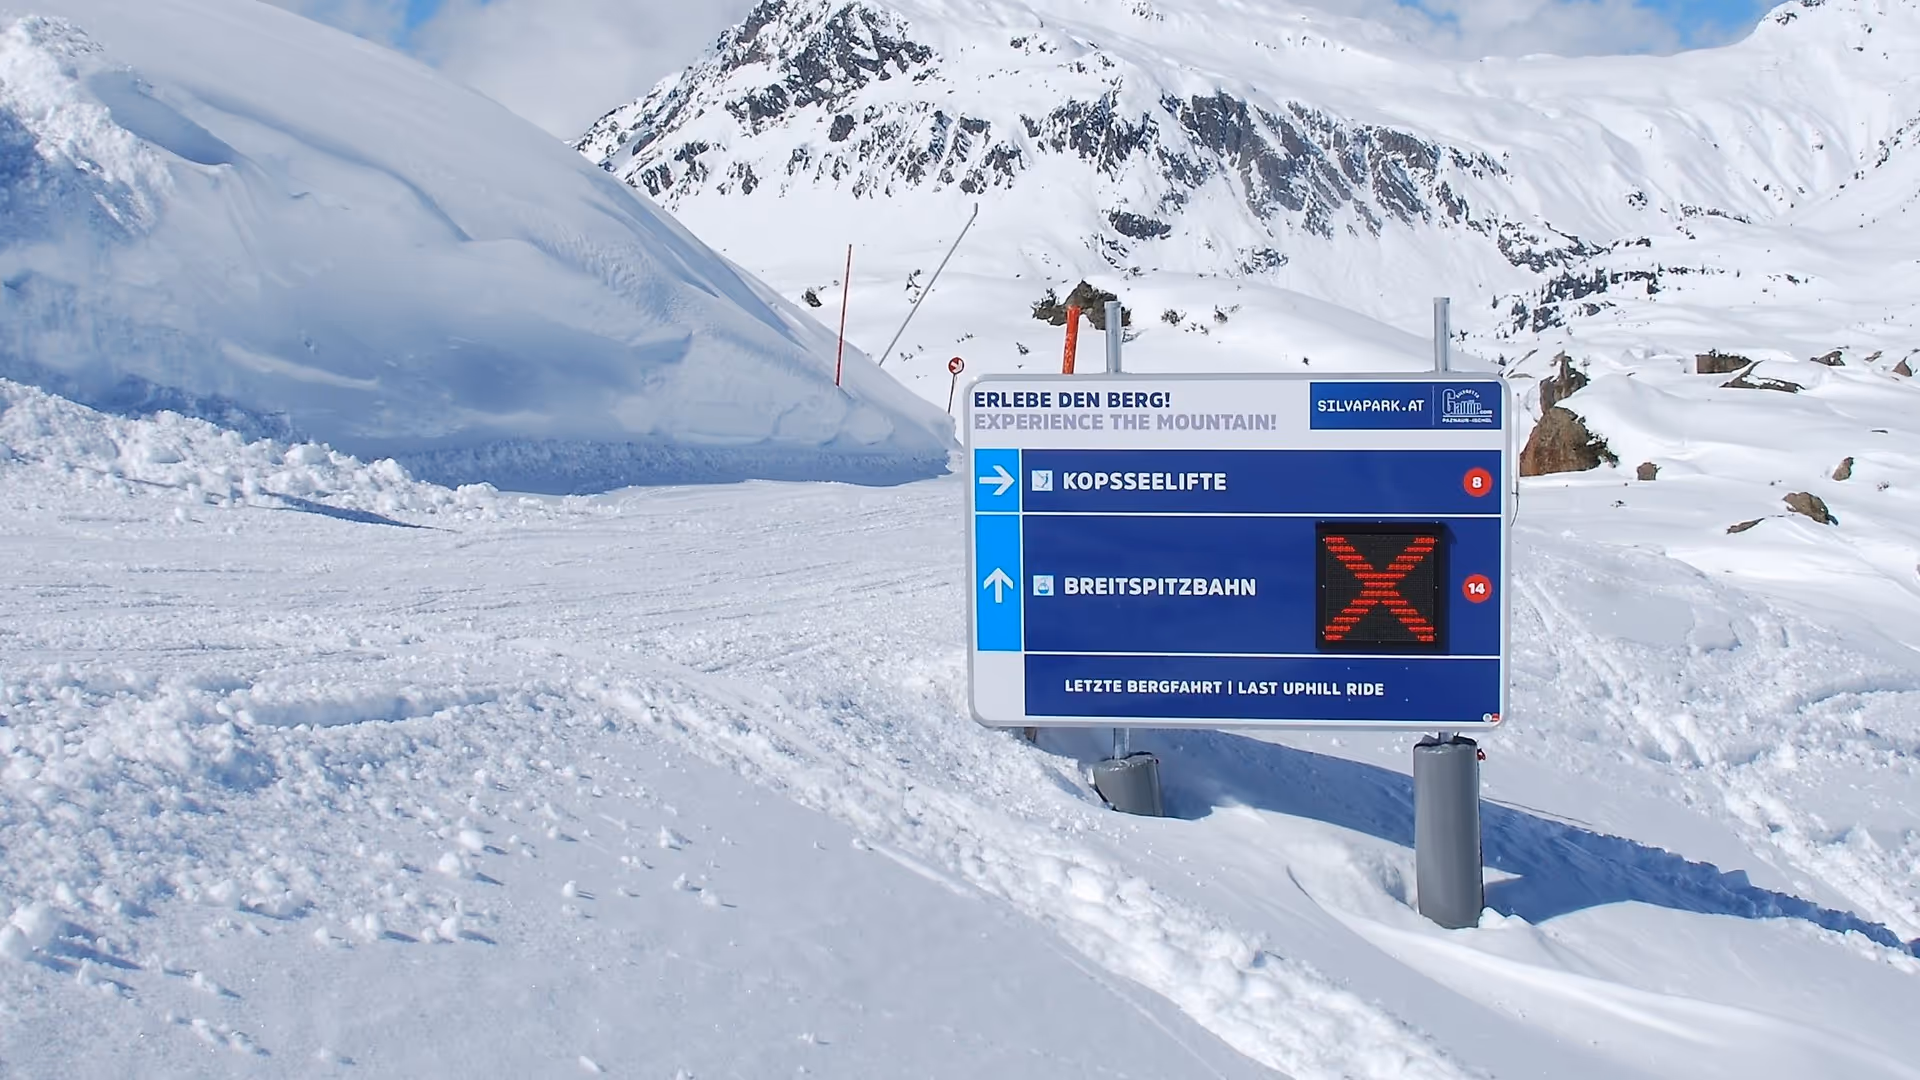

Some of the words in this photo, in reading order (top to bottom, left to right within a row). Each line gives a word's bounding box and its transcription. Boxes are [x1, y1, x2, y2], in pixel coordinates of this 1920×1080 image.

[974, 391, 1051, 408] ERLEBE
[1058, 391, 1100, 408] DEN
[1107, 391, 1171, 409] BERG!
[1317, 399, 1425, 412] SILVAPARK.AT
[974, 413, 1104, 431] EXPERIENCE
[1109, 413, 1151, 431] THE
[1156, 413, 1277, 431] MOUNTAIN!
[1063, 472, 1227, 491] KOPSSEELIFTE
[1472, 476, 1482, 489] 8
[1064, 577, 1256, 597] BREITSPITZBAHN
[1468, 582, 1486, 596] 14
[1065, 679, 1122, 693] LETZTE
[1127, 680, 1222, 694] BERGFAHRT
[1238, 681, 1278, 695] LAST
[1283, 682, 1341, 696] UPHILL
[1346, 683, 1384, 696] RIDE
